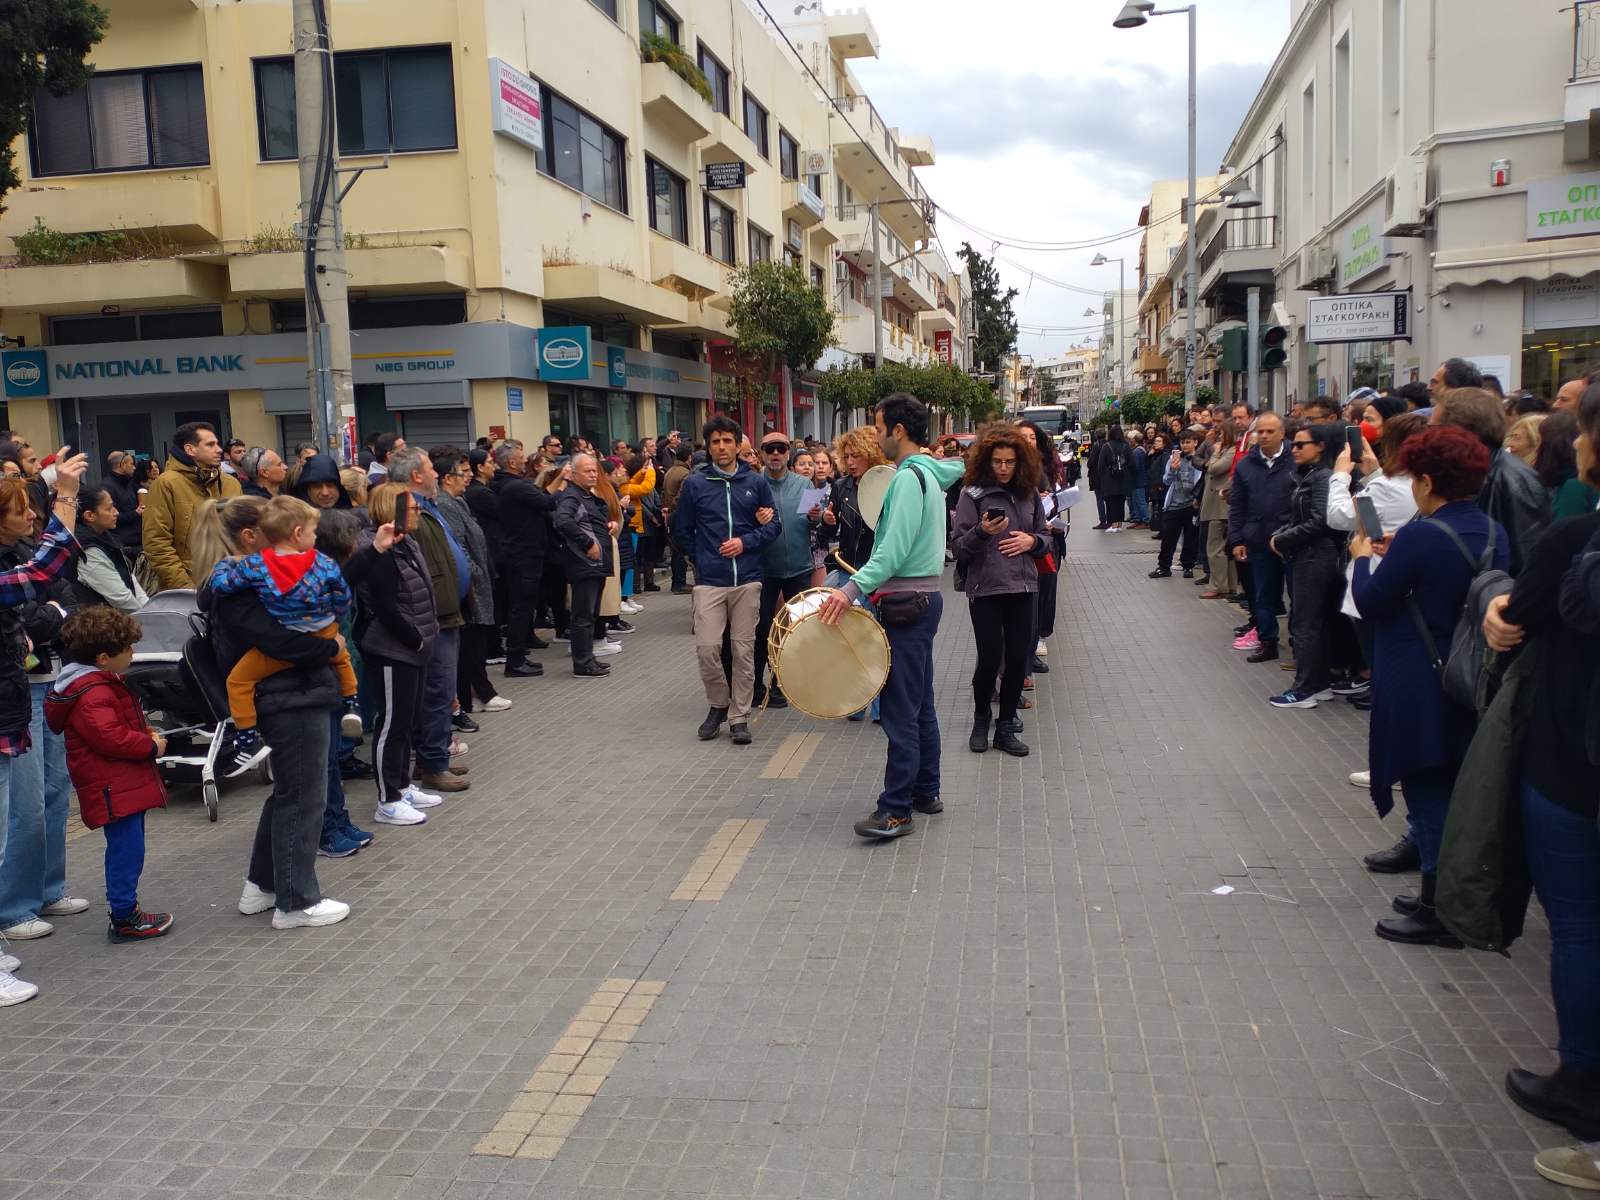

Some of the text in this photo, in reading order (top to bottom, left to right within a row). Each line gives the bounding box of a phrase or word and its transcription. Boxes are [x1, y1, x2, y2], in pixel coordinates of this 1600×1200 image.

[1568, 184, 1600, 203] ΟΠ
[1331, 301, 1373, 312] ΟΠΤΙΚΑ
[1315, 311, 1390, 323] ΣΤΑΓΚΟΥΡΑΚΗ
[937, 337, 949, 363] abit
[55, 354, 245, 380] NATIONAL BANK
[375, 359, 455, 373] NBG GROUP
